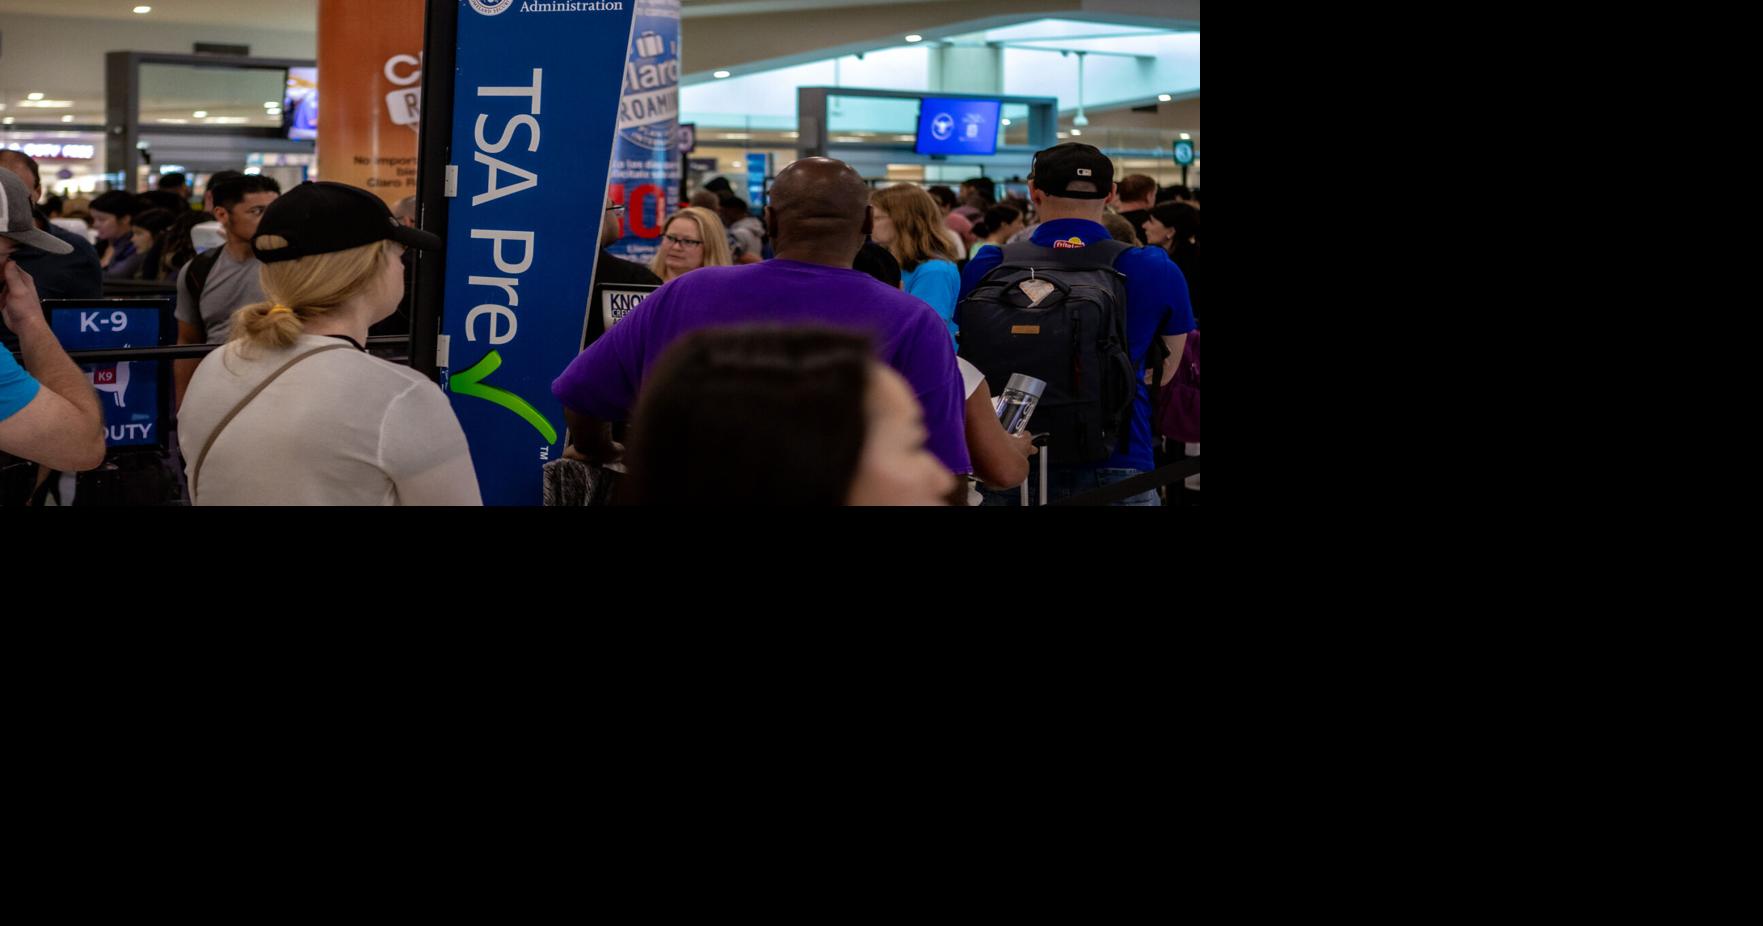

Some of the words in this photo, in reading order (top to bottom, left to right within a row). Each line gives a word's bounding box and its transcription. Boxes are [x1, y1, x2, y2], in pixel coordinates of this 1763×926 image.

[519, 0, 623, 13] Administration
[384, 49, 423, 86] C
[472, 68, 543, 207] TSA
[465, 229, 535, 345] Pre
[610, 293, 646, 311] KNO
[80, 311, 128, 332] K-9
[98, 371, 113, 382] K9
